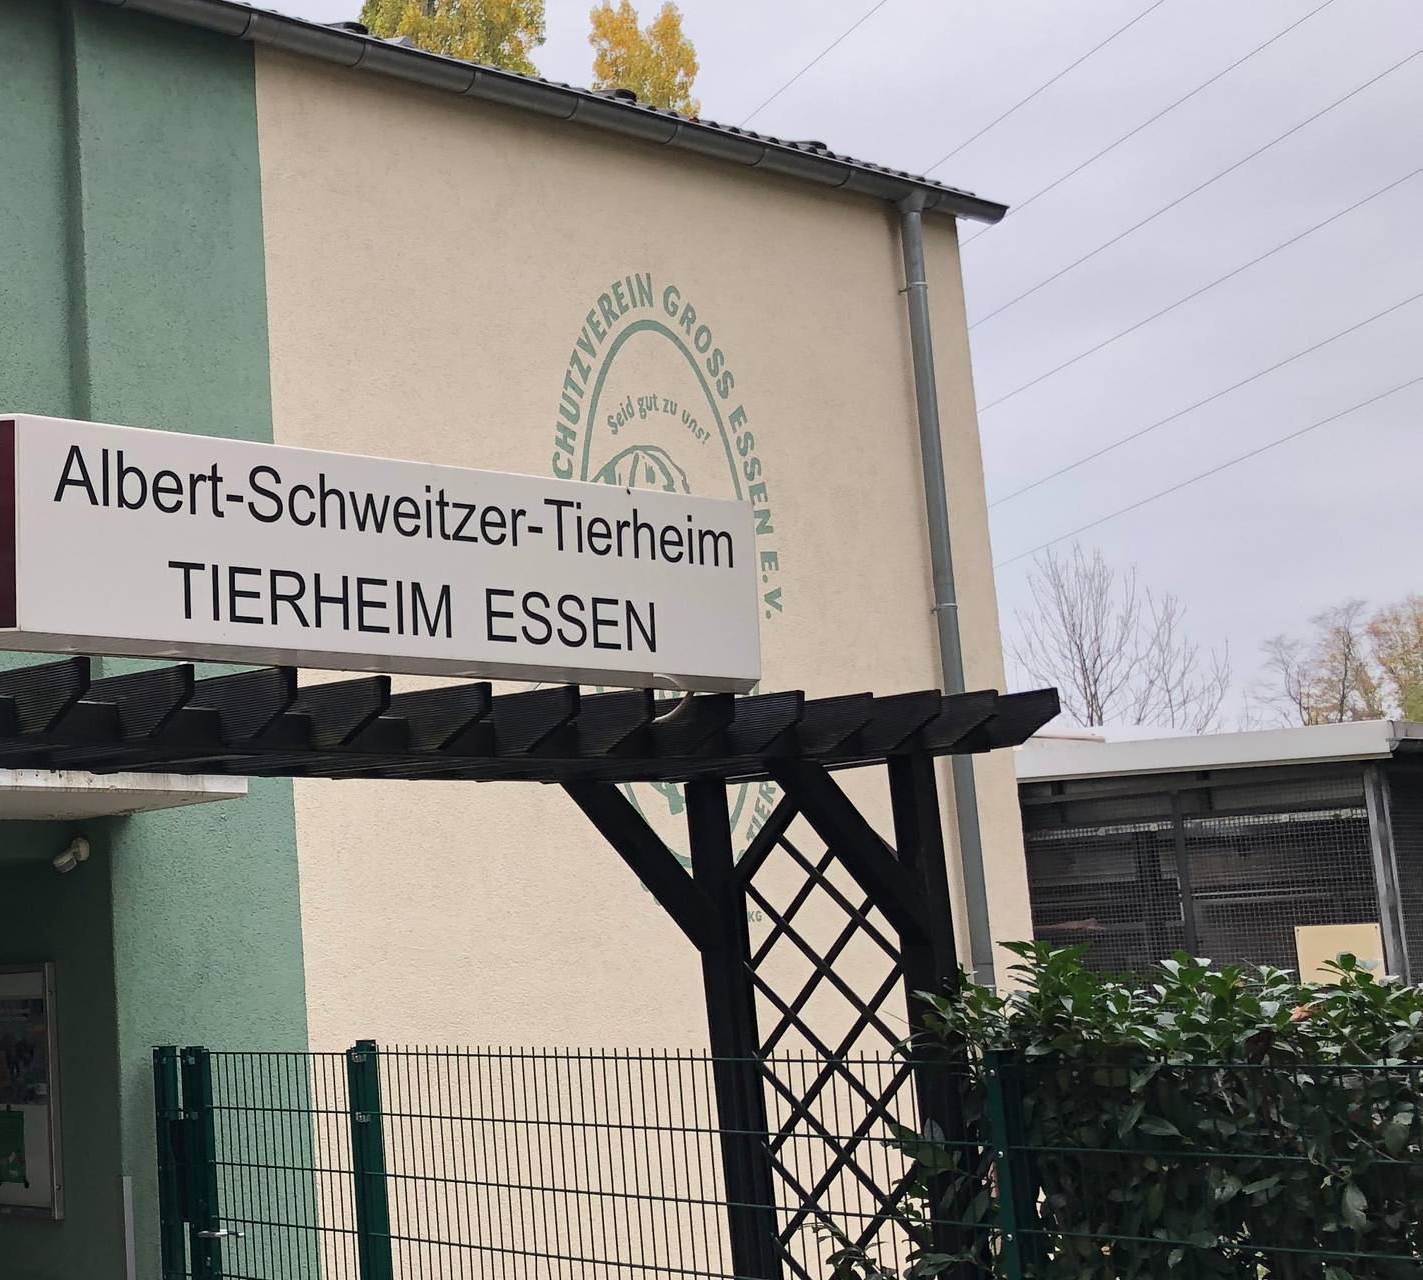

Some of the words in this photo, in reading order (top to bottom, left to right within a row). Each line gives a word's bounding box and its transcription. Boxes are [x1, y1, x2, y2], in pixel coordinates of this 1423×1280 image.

[607, 395, 635, 435] Seid
[637, 393, 659, 420] gut
[663, 398, 678, 416] zu
[681, 409, 711, 444] uns!
[662, 285, 735, 400] GROSS
[728, 404, 774, 535] ESSEN
[54, 443, 735, 569] Albert-Schweitzer-Tierheim
[167, 559, 453, 640] TIERHEIM
[484, 587, 658, 654] ESSEN
